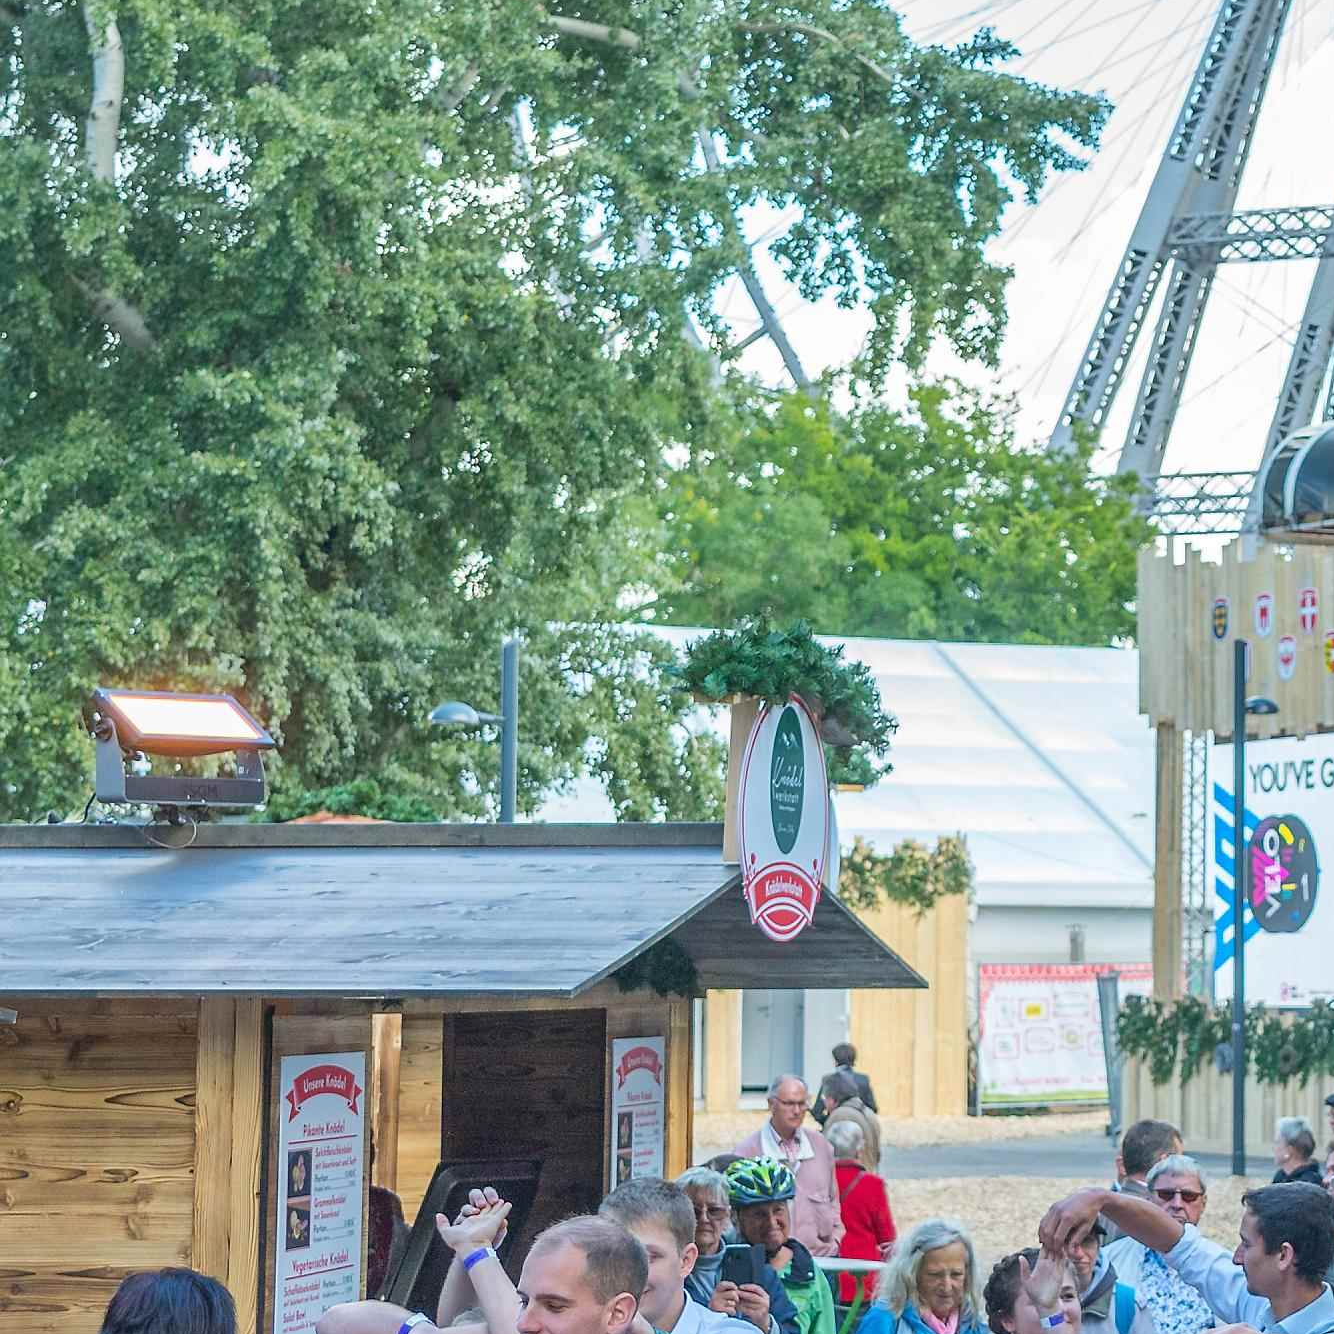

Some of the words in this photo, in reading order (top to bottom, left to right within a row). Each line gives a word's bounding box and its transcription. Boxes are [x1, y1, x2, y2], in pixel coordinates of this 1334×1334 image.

[1250, 760, 1314, 793] YOU'VE
[303, 1078, 325, 1094] Unsere
[325, 1074, 347, 1089] Knödel
